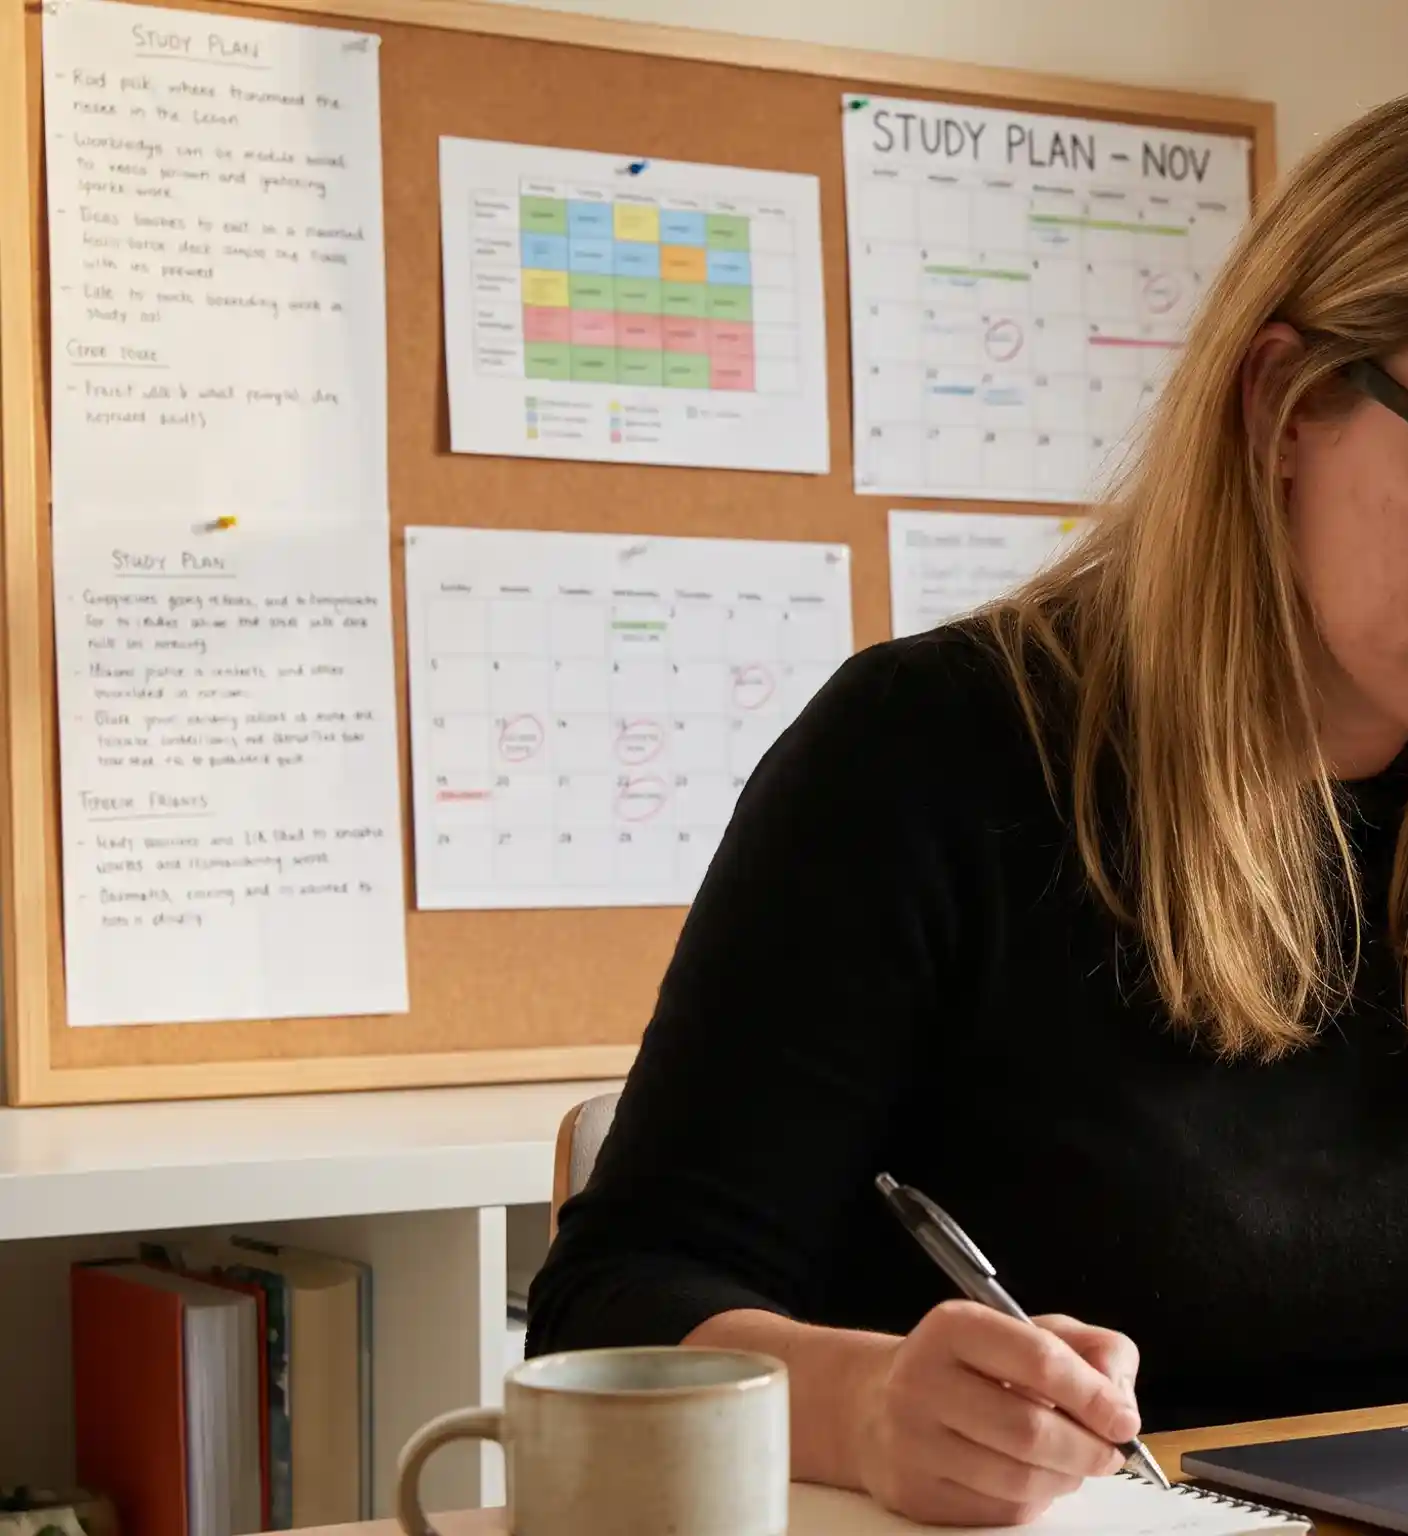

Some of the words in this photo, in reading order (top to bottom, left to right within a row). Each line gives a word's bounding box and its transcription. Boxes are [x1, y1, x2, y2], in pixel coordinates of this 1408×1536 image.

[131, 23, 192, 53] STUDY
[872, 110, 987, 161] STUDY
[1006, 123, 1096, 172] PLAN
[1141, 141, 1212, 184] NOV
[111, 548, 167, 571] STUDY
[181, 550, 225, 570] PLAN
